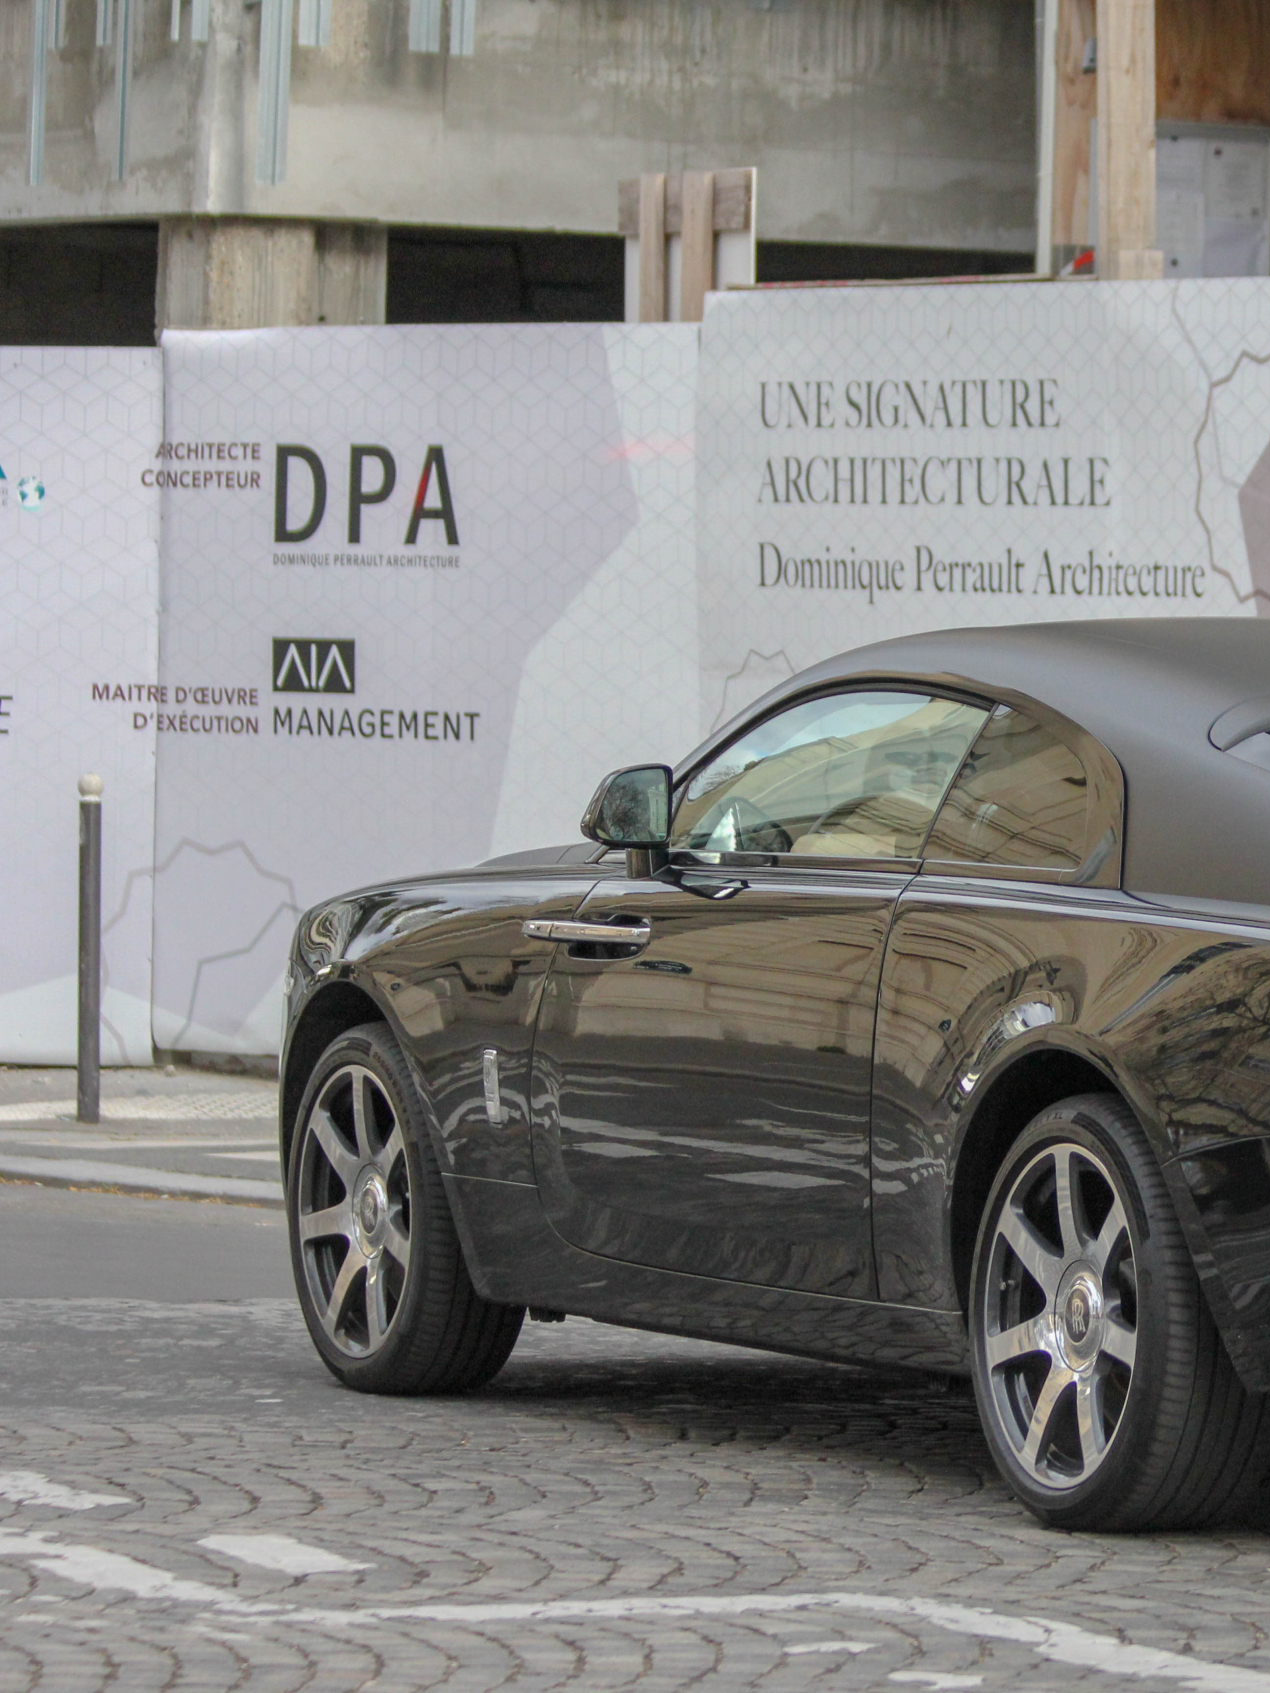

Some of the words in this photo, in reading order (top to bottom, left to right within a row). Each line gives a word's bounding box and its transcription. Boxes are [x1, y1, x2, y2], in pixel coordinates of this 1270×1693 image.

[758, 380, 835, 429] UNE
[845, 378, 1061, 429] SIGNATURE
[155, 442, 262, 461] ARCHITECTE
[141, 469, 261, 489] CONCEPTEUR
[757, 456, 1112, 508] ARCHITECTURALE
[274, 443, 460, 546] DPA
[273, 553, 330, 568] DOMINIQUE
[333, 553, 384, 568] PERRAULT
[386, 554, 460, 569] ARCHITECTURE
[757, 541, 905, 604] Dominique
[915, 545, 1025, 595] Perrault
[1033, 548, 1206, 598] Architecture
[92, 683, 168, 702] MAITRE
[175, 686, 259, 706] D'ŒUVRE
[133, 710, 259, 735] D'EXÉCUTION
[273, 706, 481, 742] MANAGEMENT
